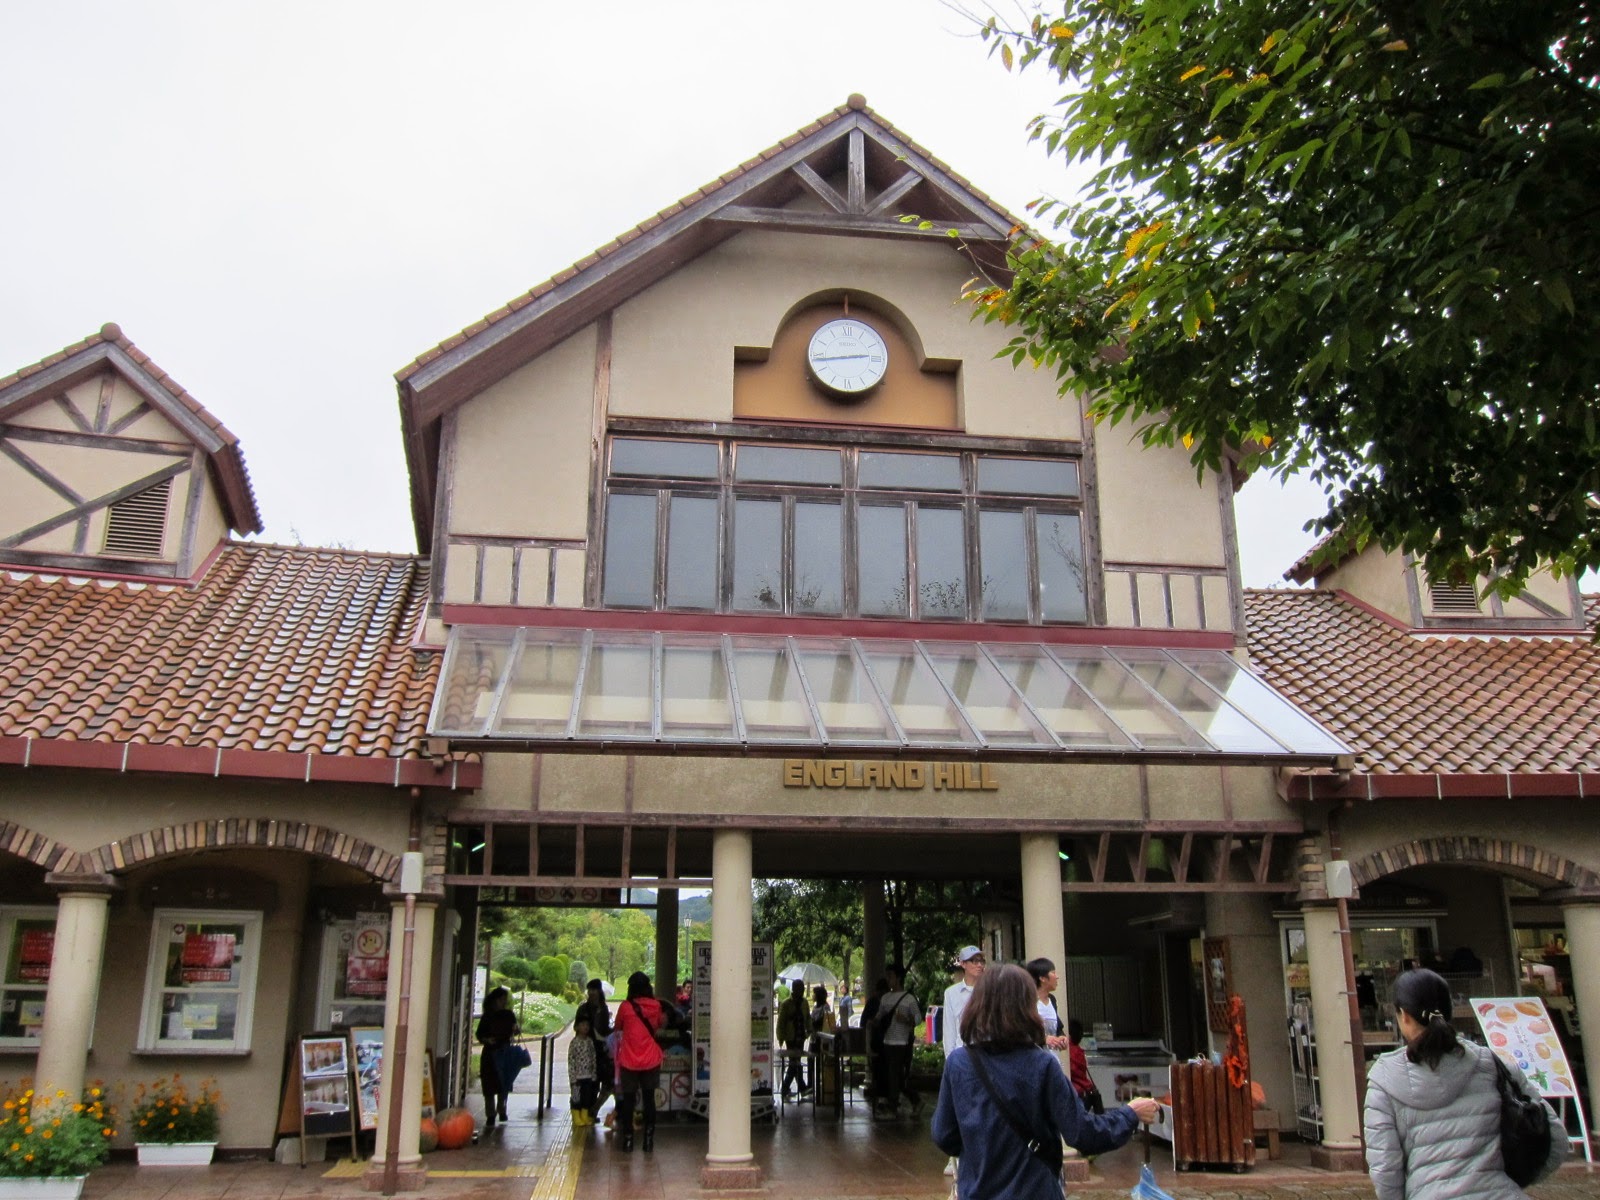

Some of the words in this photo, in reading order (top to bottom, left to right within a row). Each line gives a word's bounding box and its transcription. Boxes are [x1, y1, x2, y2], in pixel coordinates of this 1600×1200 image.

[842, 326, 853, 337] XII
[784, 759, 925, 788] ENGLAND
[933, 762, 999, 790] HILL
